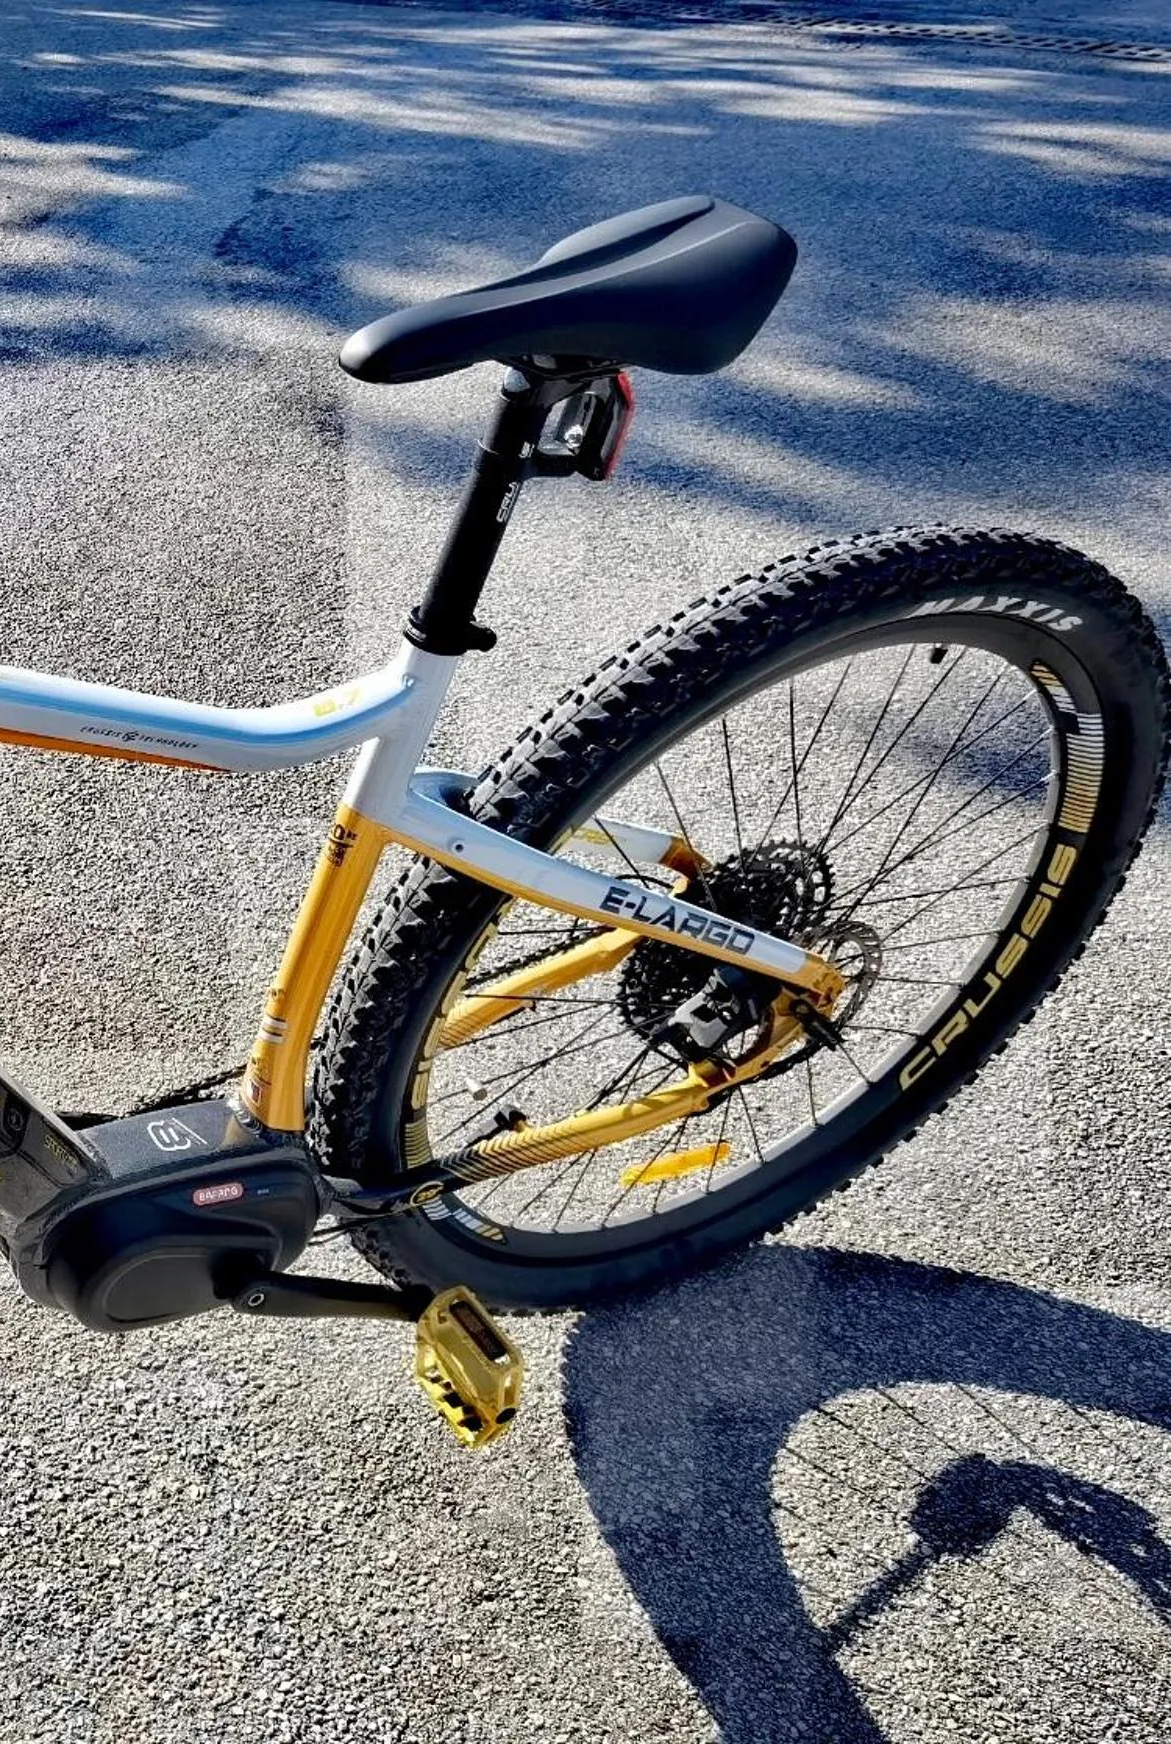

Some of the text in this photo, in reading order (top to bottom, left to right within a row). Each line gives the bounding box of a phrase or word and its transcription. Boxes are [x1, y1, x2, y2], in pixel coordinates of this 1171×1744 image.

[907, 596, 1083, 632] MAXXIS
[599, 886, 755, 955] E-LARGO
[897, 844, 1078, 1091] CRUSSIS
